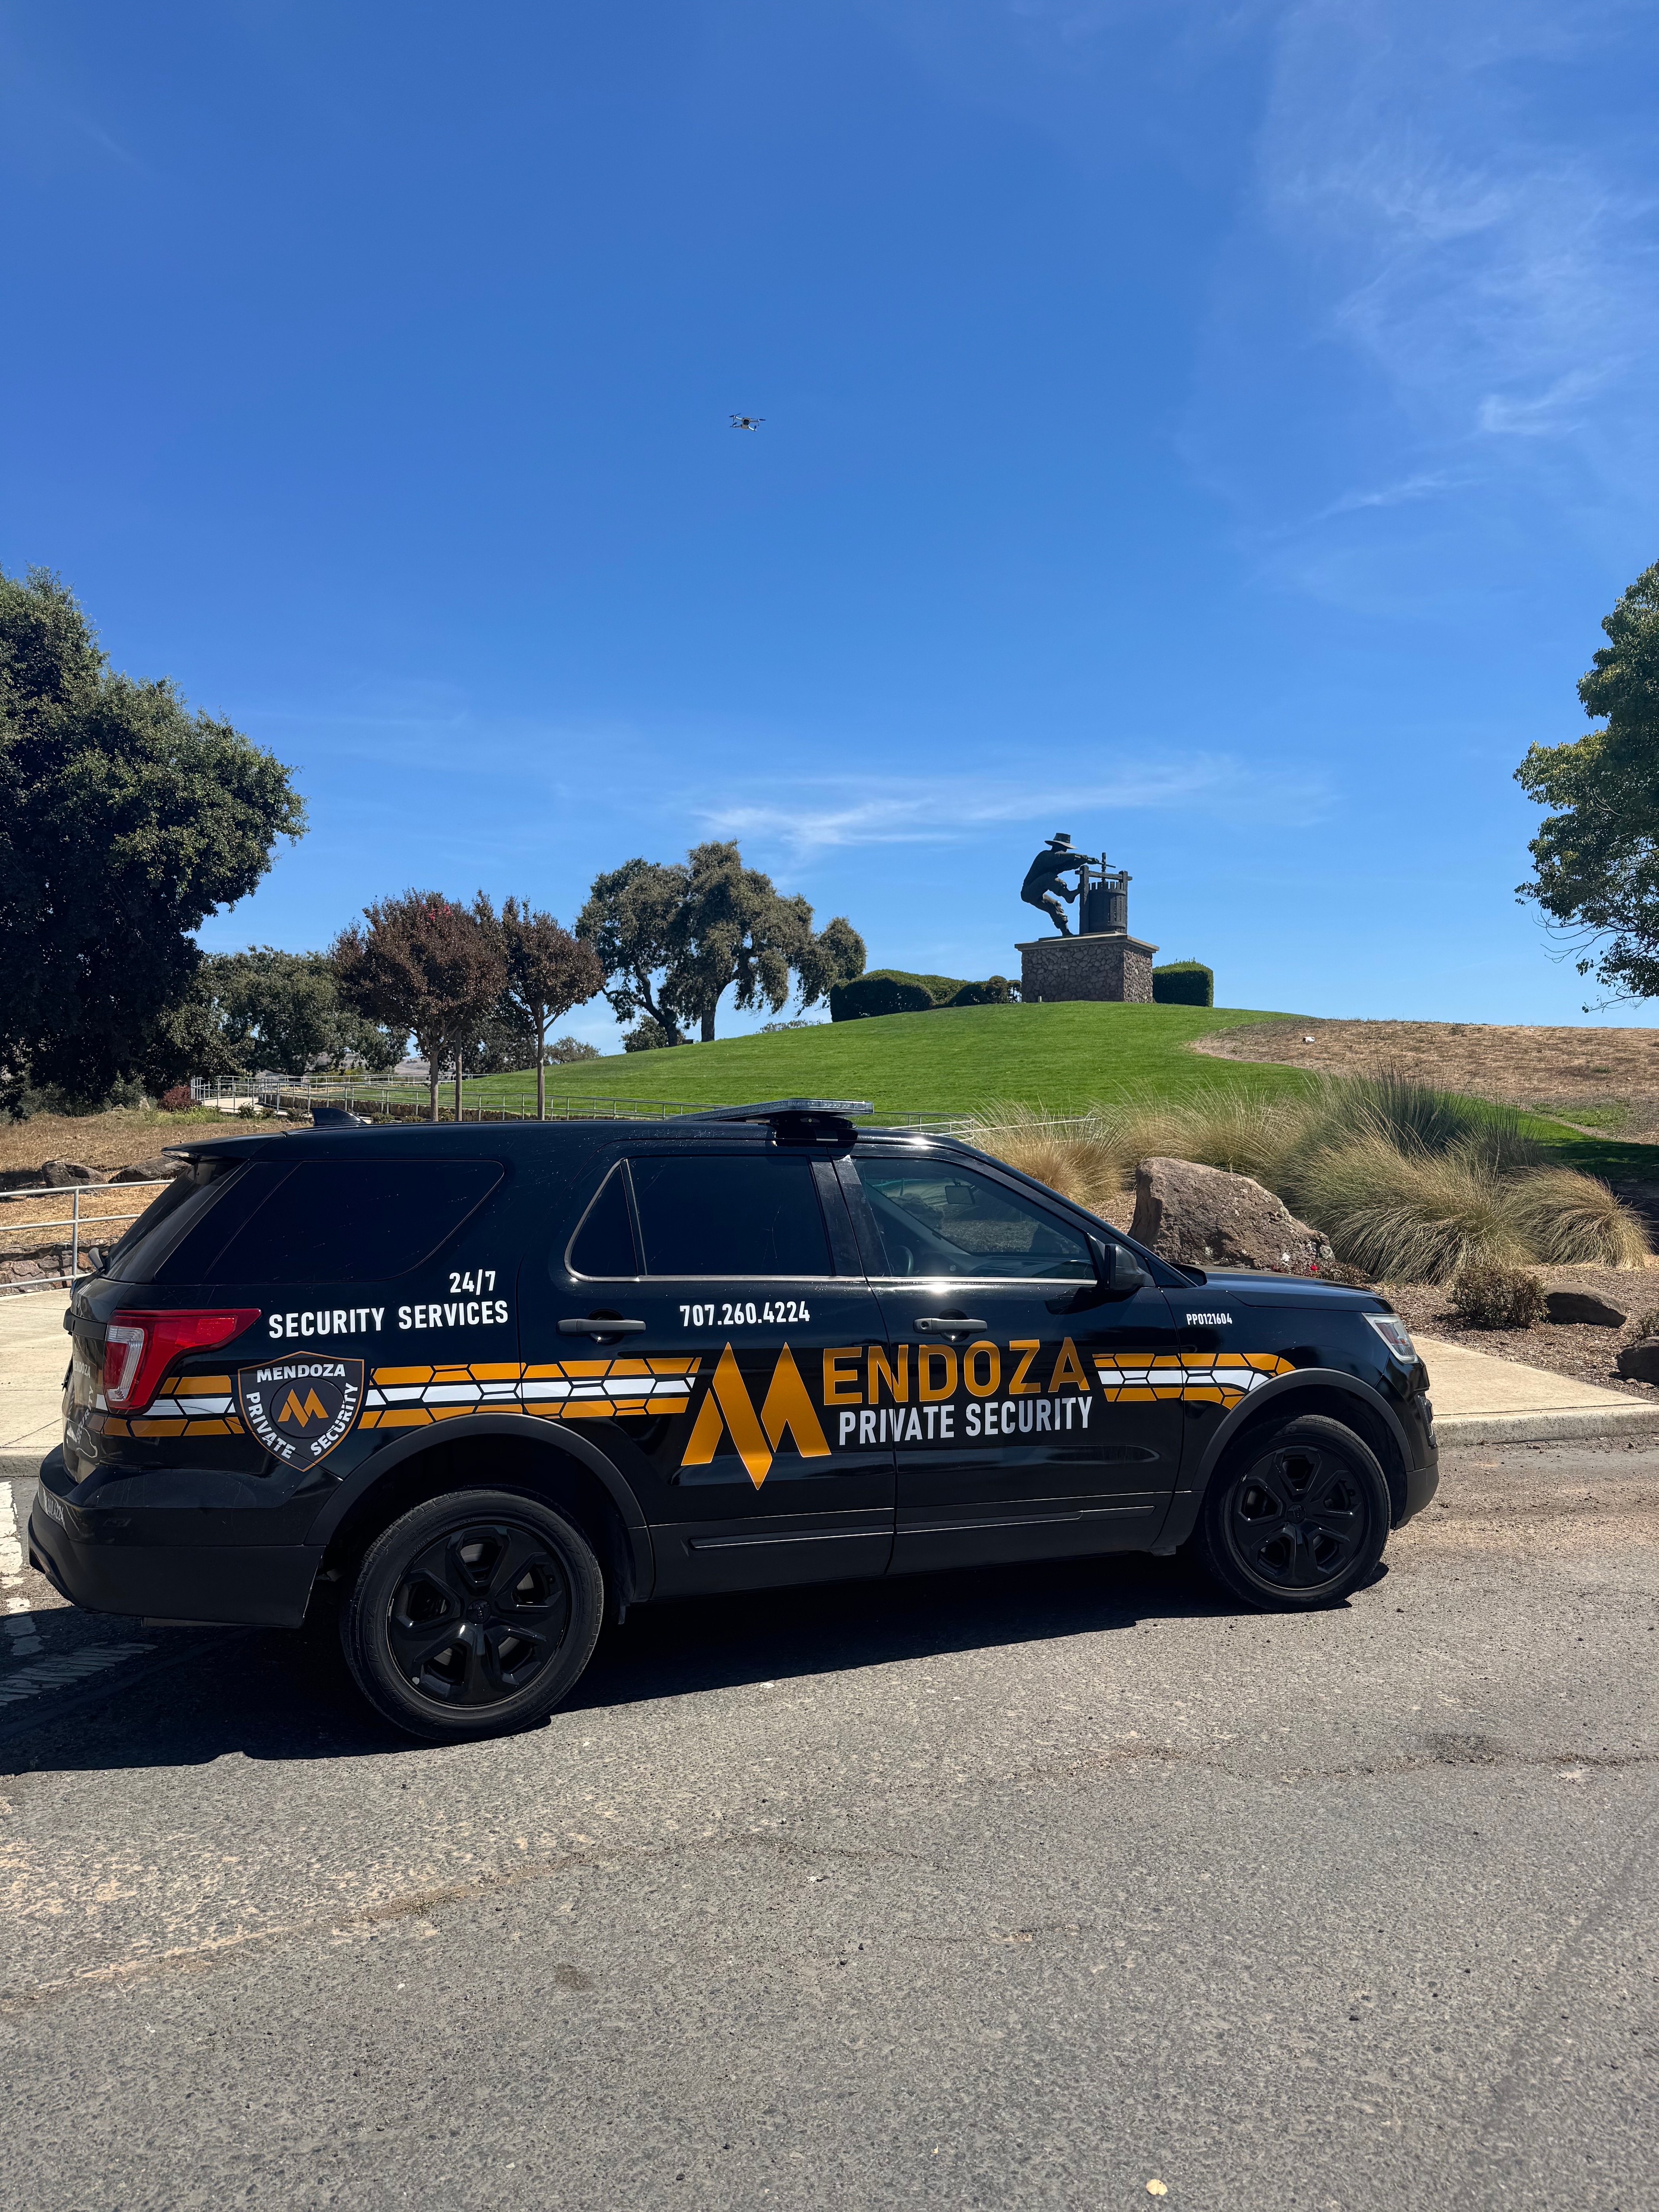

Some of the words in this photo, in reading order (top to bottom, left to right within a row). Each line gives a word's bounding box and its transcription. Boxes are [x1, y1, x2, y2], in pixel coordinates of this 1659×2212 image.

[449, 1269, 496, 1295] 24/7
[269, 1307, 385, 1338] SECURITY
[398, 1300, 509, 1330] SERVICES
[680, 1301, 810, 1327] 707.260.4224
[257, 1363, 346, 1383] MENDOZA
[246, 1392, 296, 1459] PRIVATE
[310, 1382, 358, 1456] SECURITY
[838, 1405, 954, 1446] PRIVATE
[966, 1396, 1093, 1437] SECURITY
